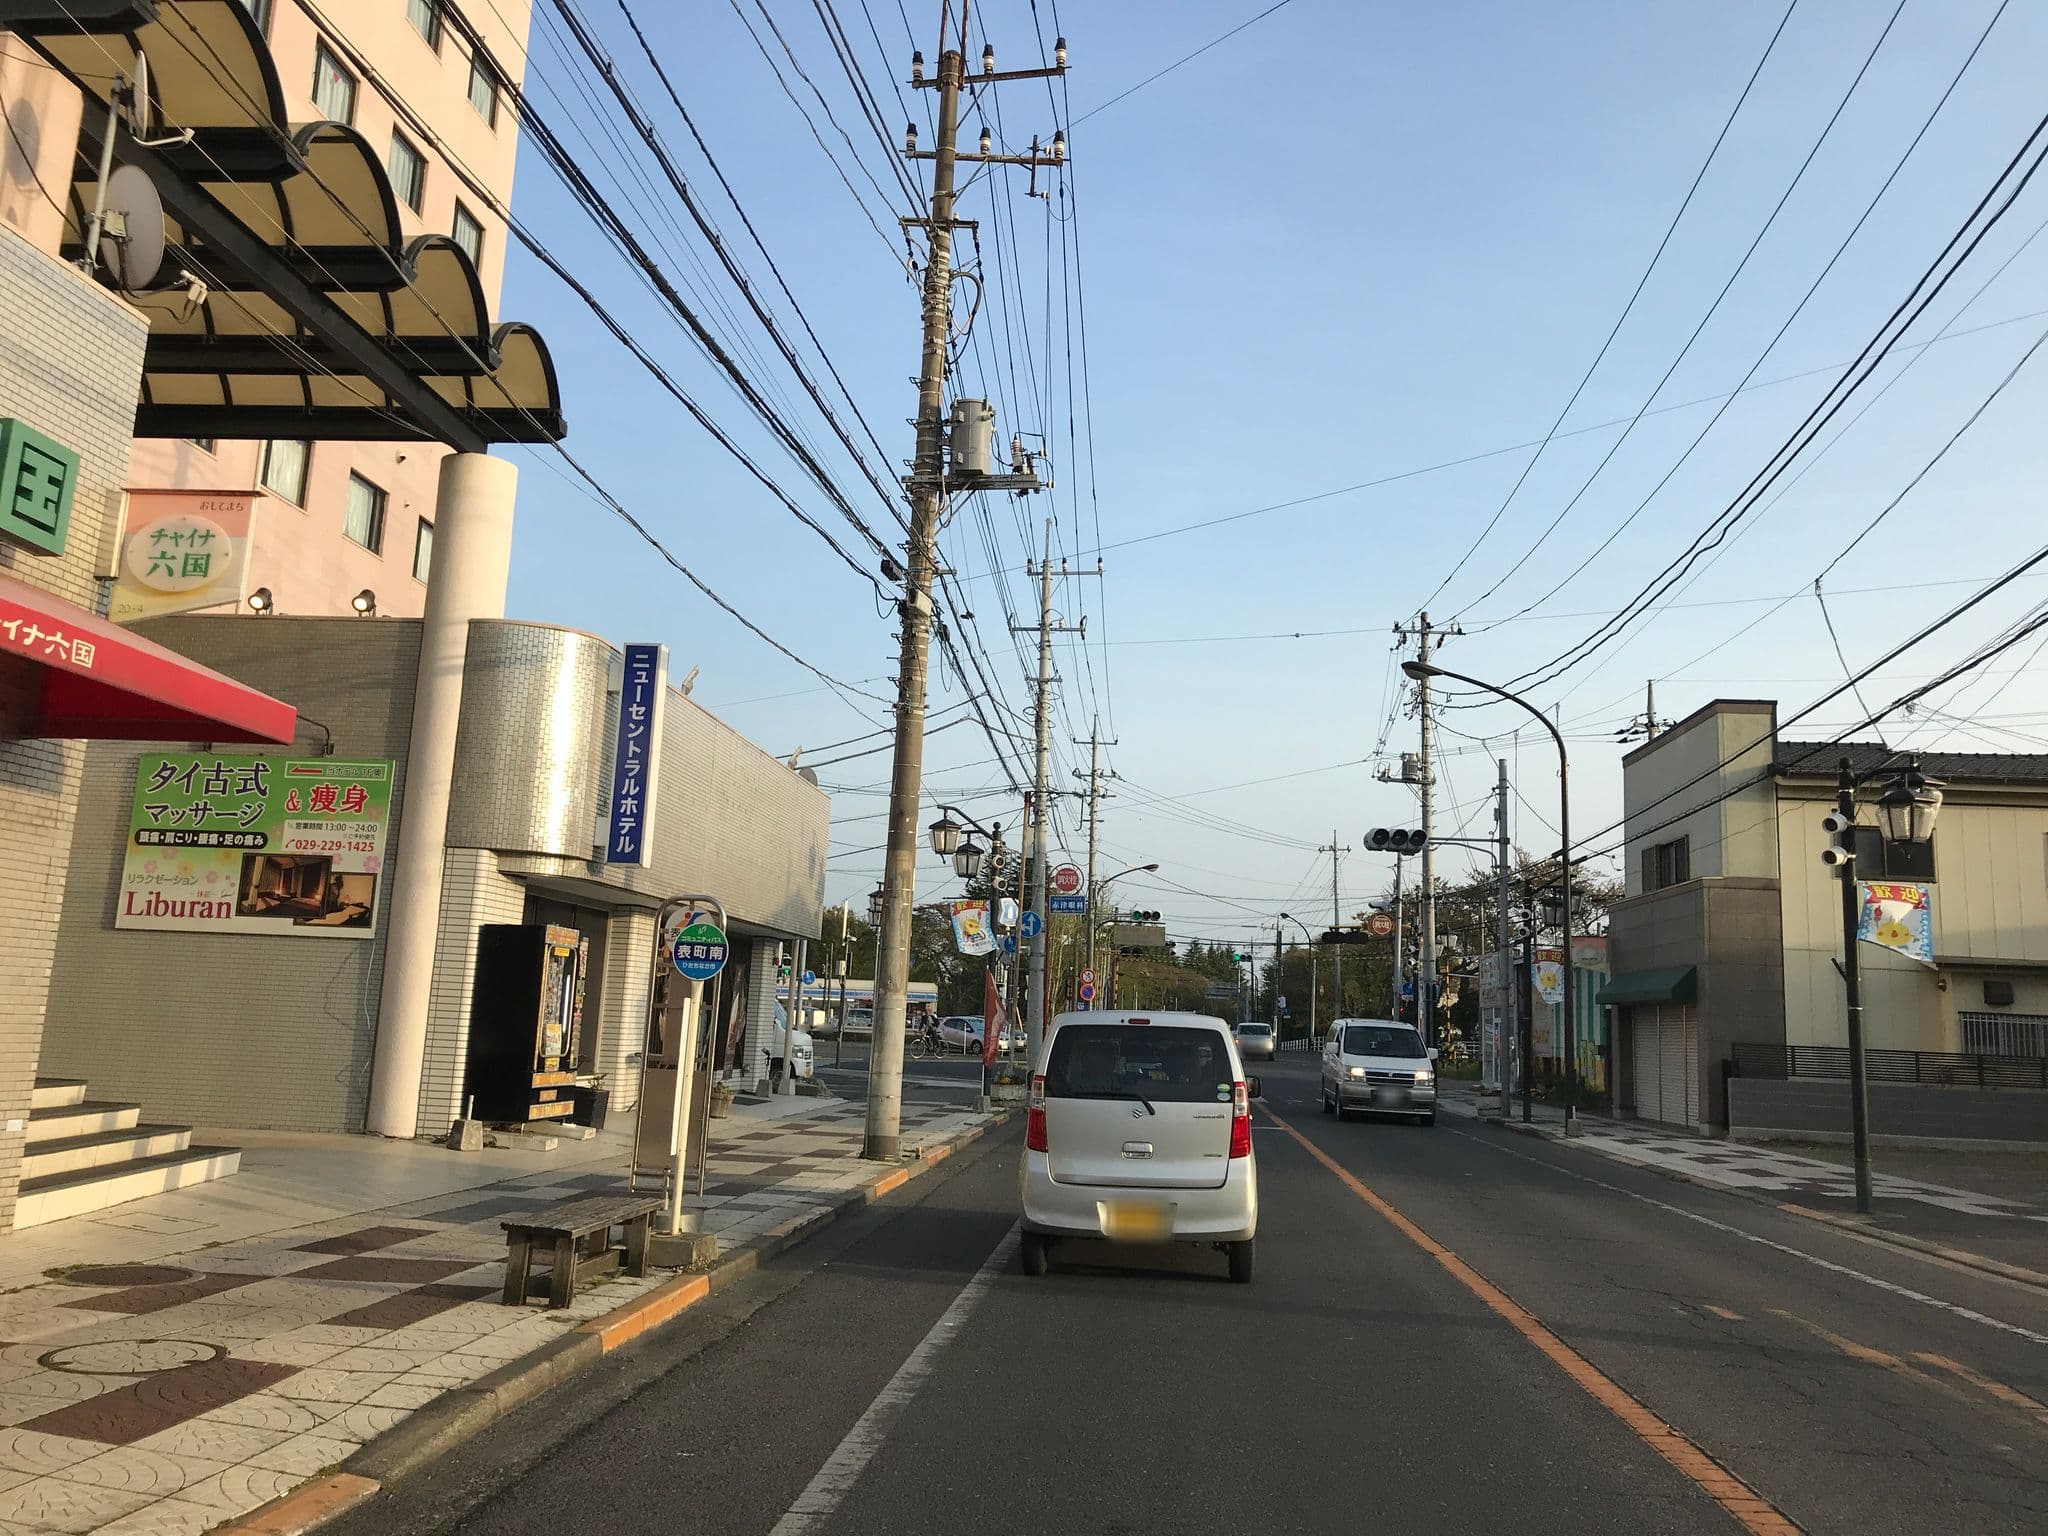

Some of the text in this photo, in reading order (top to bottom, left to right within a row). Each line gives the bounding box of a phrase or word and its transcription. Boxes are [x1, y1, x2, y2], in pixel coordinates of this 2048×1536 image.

[200, 501, 244, 512] おもてまち
[150, 527, 216, 548] チャイナ
[146, 550, 212, 578] 六国
[0, 619, 96, 669] イナ六国
[615, 653, 651, 855] ニューセントラルホテル
[146, 760, 271, 797] タイ古式
[286, 783, 369, 814] & 痩身
[144, 800, 265, 828] マッサージ
[295, 822, 323, 830] 営業時間
[295, 839, 375, 852] 029-229-1425
[128, 873, 200, 886] リラクゼーション
[124, 890, 232, 919] Liburan
[1872, 885, 1920, 904] 歓迎
[681, 935, 722, 943] コミュニティバス
[677, 944, 724, 960] 表町南
[682, 962, 716, 970] ひたちなか市
